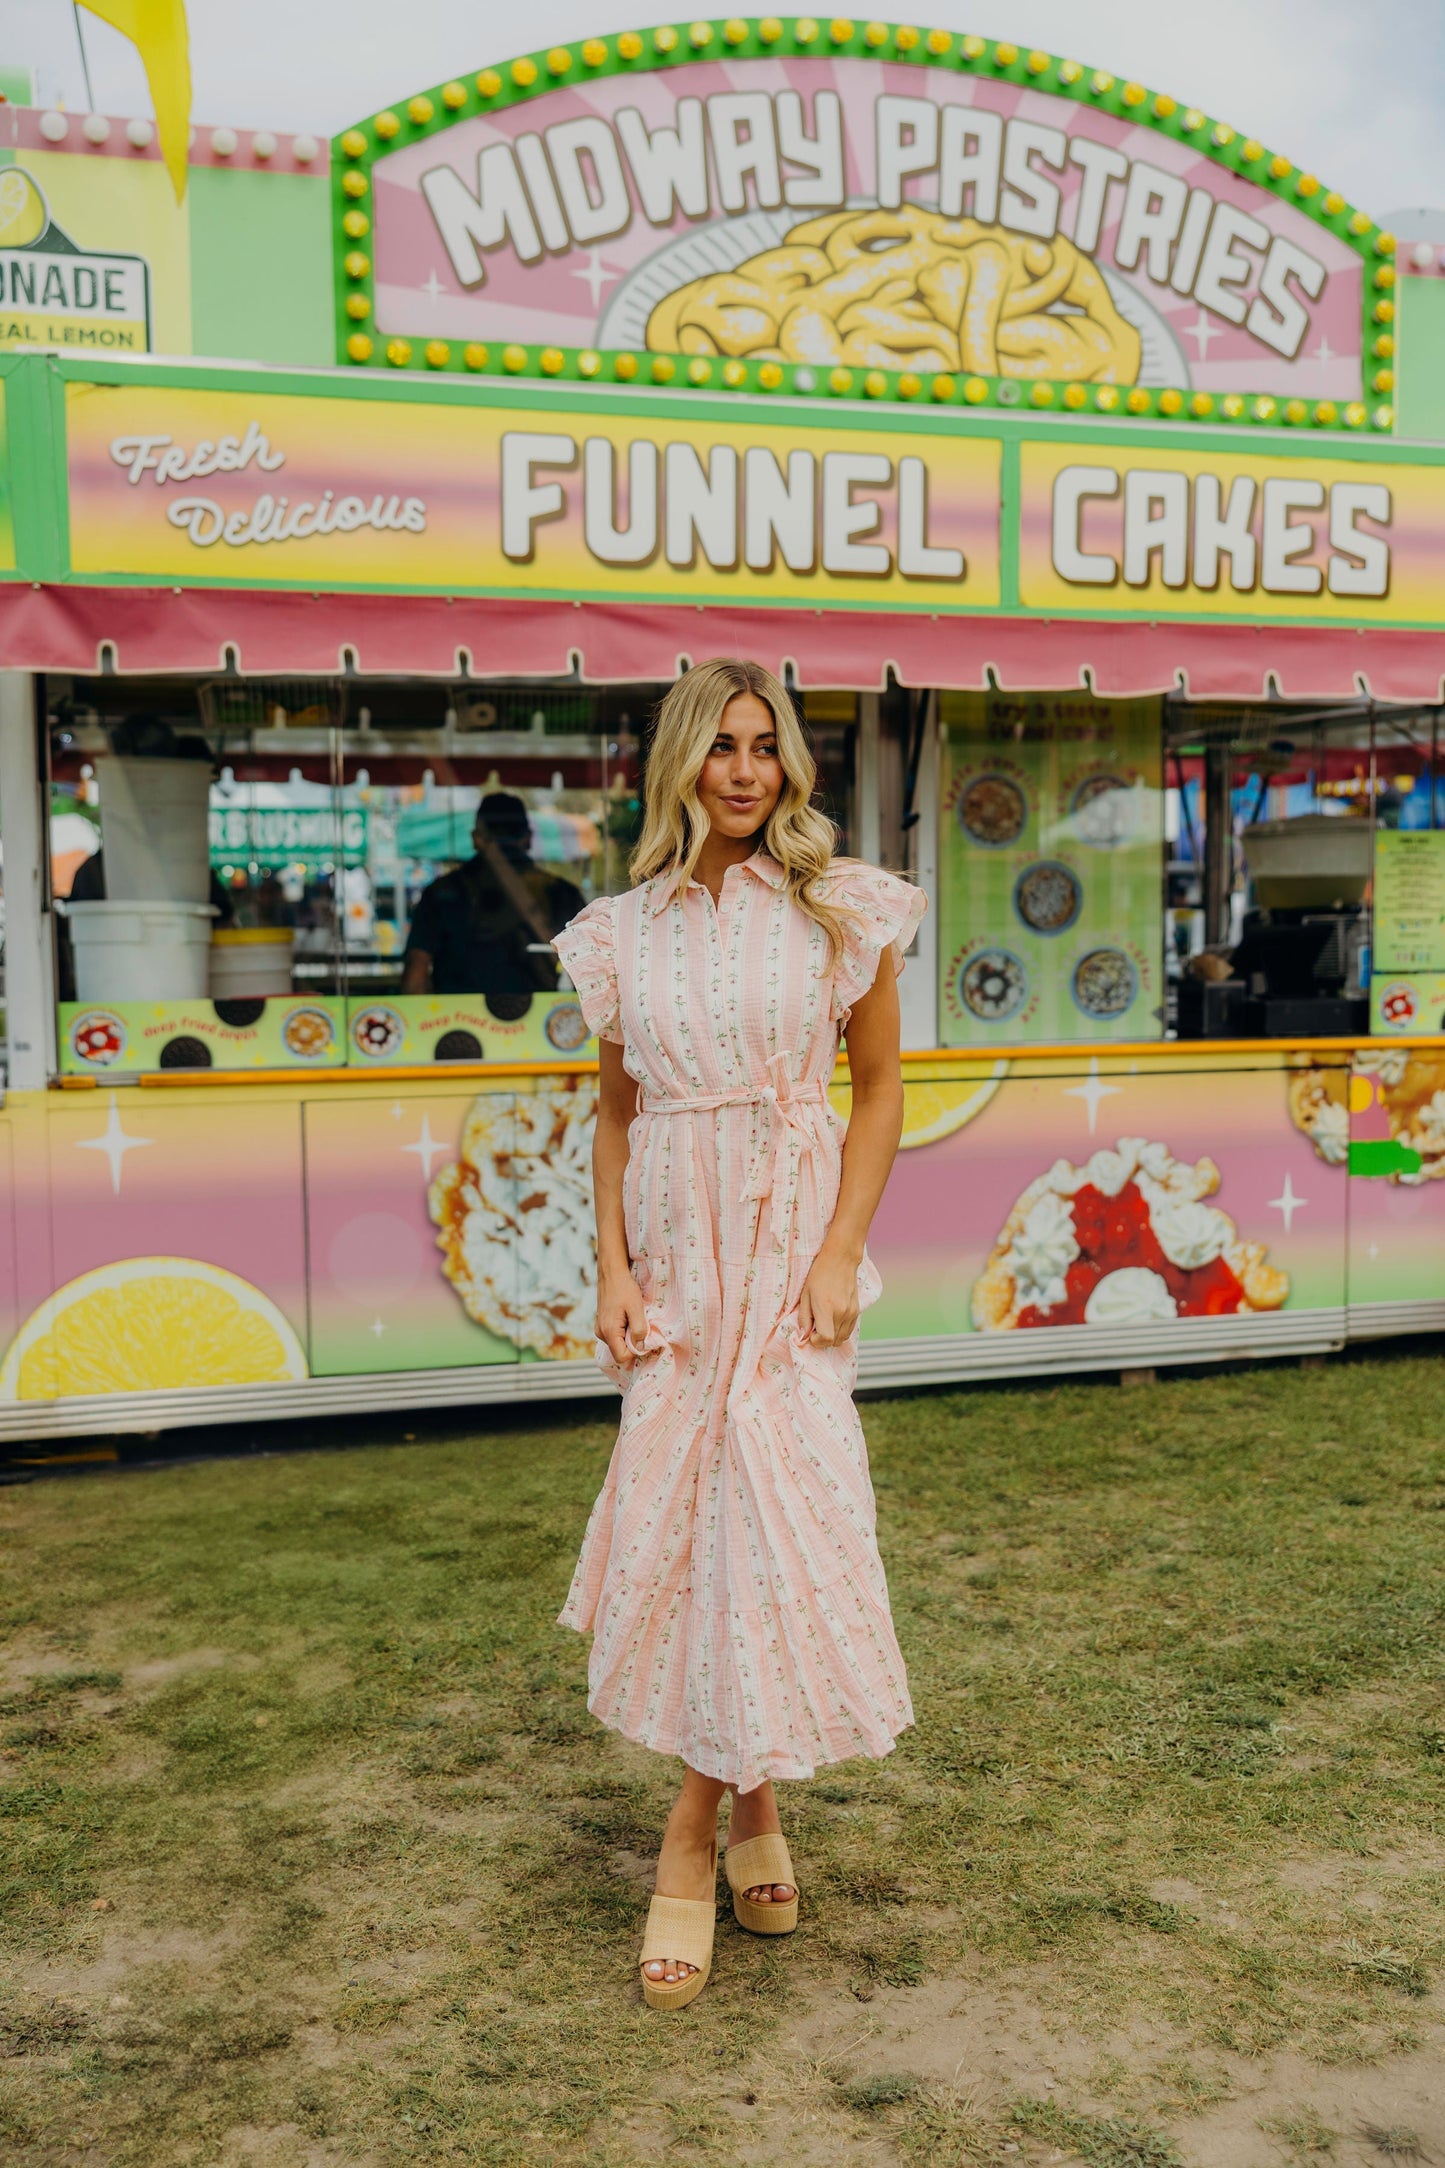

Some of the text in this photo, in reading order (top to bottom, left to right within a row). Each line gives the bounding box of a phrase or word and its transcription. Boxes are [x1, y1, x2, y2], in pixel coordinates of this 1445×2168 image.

[420, 89, 1327, 362] MIDWAY PASTRIES
[0, 323, 134, 347] AL LEMON
[109, 420, 286, 486] Fresh
[167, 489, 427, 547] Delicious
[501, 431, 1393, 599] FUNNEL CAKES
[143, 1020, 177, 1038] deep
[180, 1014, 217, 1033] fried
[419, 1015, 451, 1031] deep
[454, 1011, 488, 1029] fried
